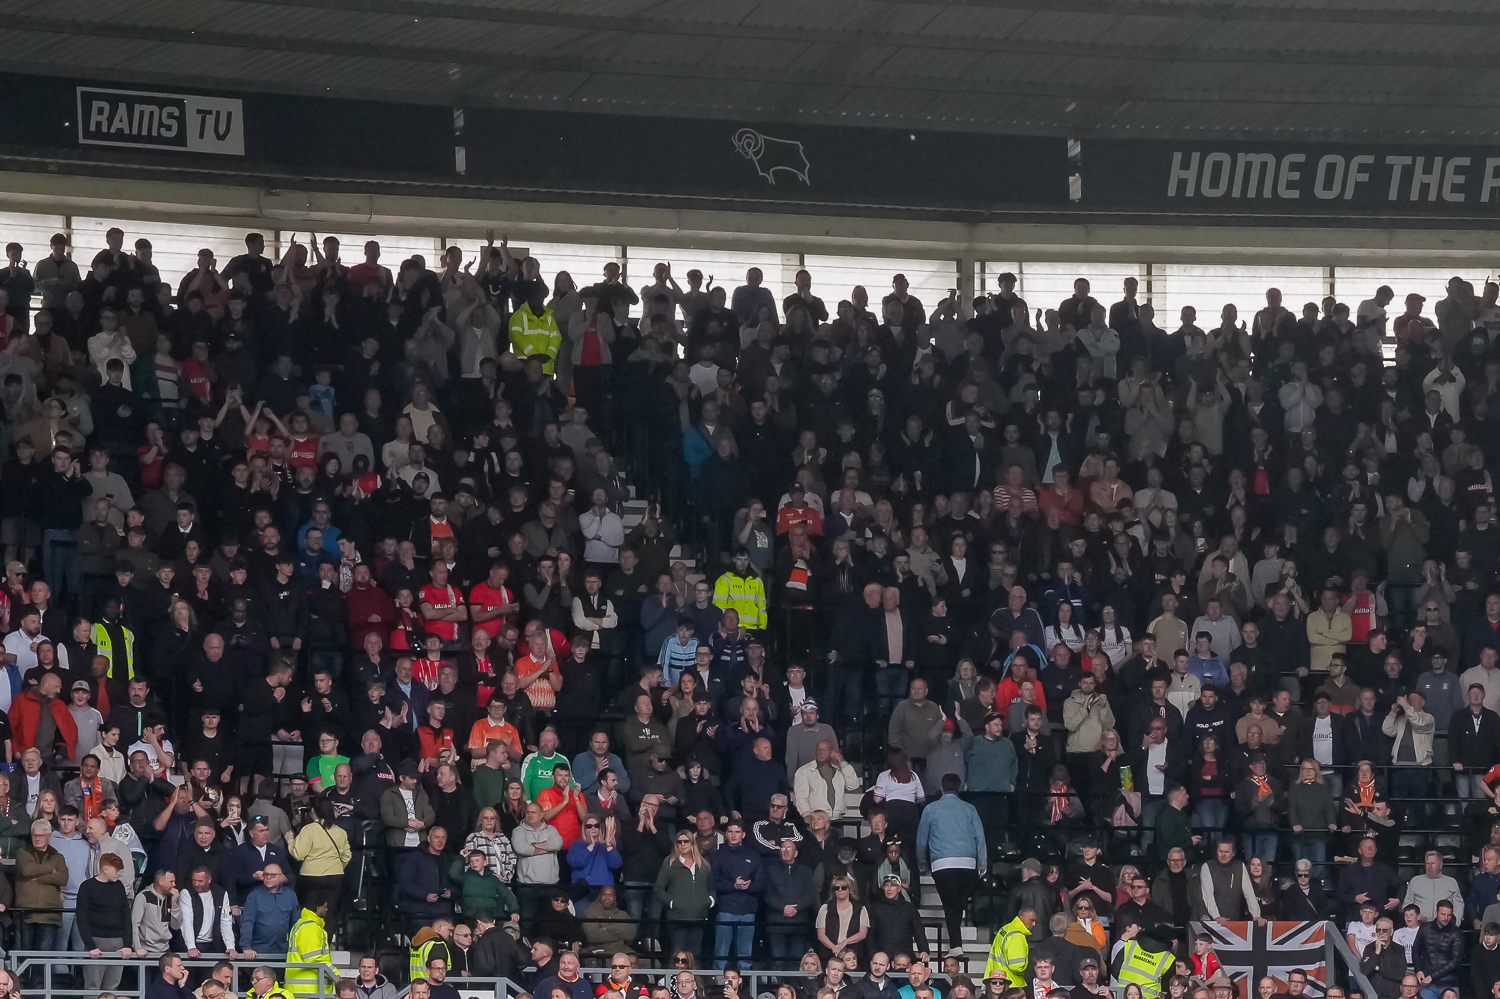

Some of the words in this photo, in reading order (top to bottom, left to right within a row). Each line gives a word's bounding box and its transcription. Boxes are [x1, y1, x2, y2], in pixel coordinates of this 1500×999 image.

[89, 100, 180, 138] RAMS
[195, 108, 233, 141] TV
[1167, 150, 1306, 199] HOME
[1313, 153, 1375, 201] OF
[1385, 155, 1471, 203] THE
[100, 640, 106, 648] 41
